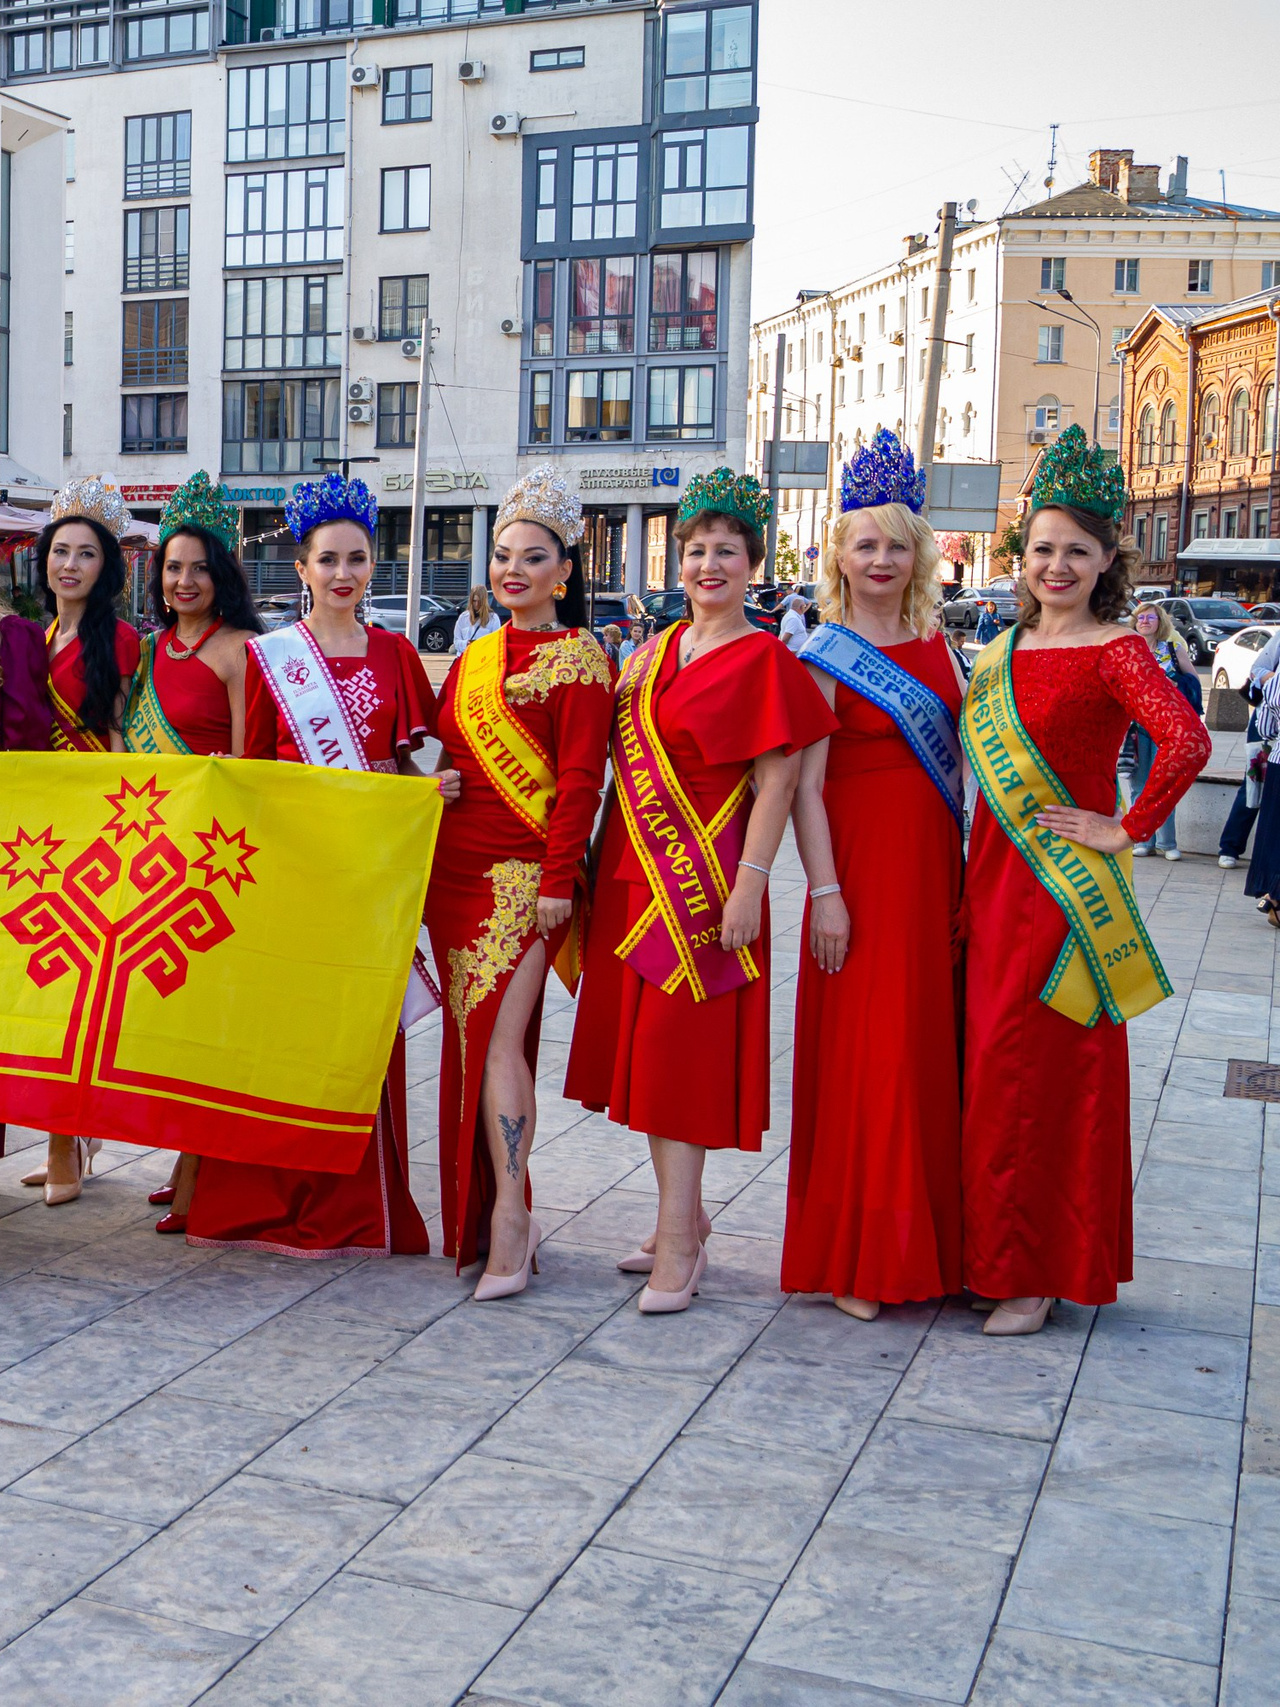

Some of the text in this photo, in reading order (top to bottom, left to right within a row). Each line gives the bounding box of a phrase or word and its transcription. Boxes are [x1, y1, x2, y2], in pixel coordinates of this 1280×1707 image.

[151, 484, 179, 493] ЛЕЧЕ
[578, 467, 649, 478] СЛУХОВЫЕ
[578, 478, 648, 489] АППАРАТЫ
[221, 483, 286, 506] Доктор
[484, 677, 503, 727] ГРАН-ПРИ
[858, 651, 938, 717] ПЕРВАЯ ВИЦЕ
[849, 658, 957, 777] БЕРЕГИНЯ
[974, 666, 1025, 796] БЕРЕГИНЯ
[991, 702, 1009, 732] ВИЦЕ
[468, 683, 543, 801] БЕРЕГИНЯ
[616, 648, 710, 918] БЕРЕГИНЯ МУДРОСТИ
[1103, 938, 1140, 969] 2025
